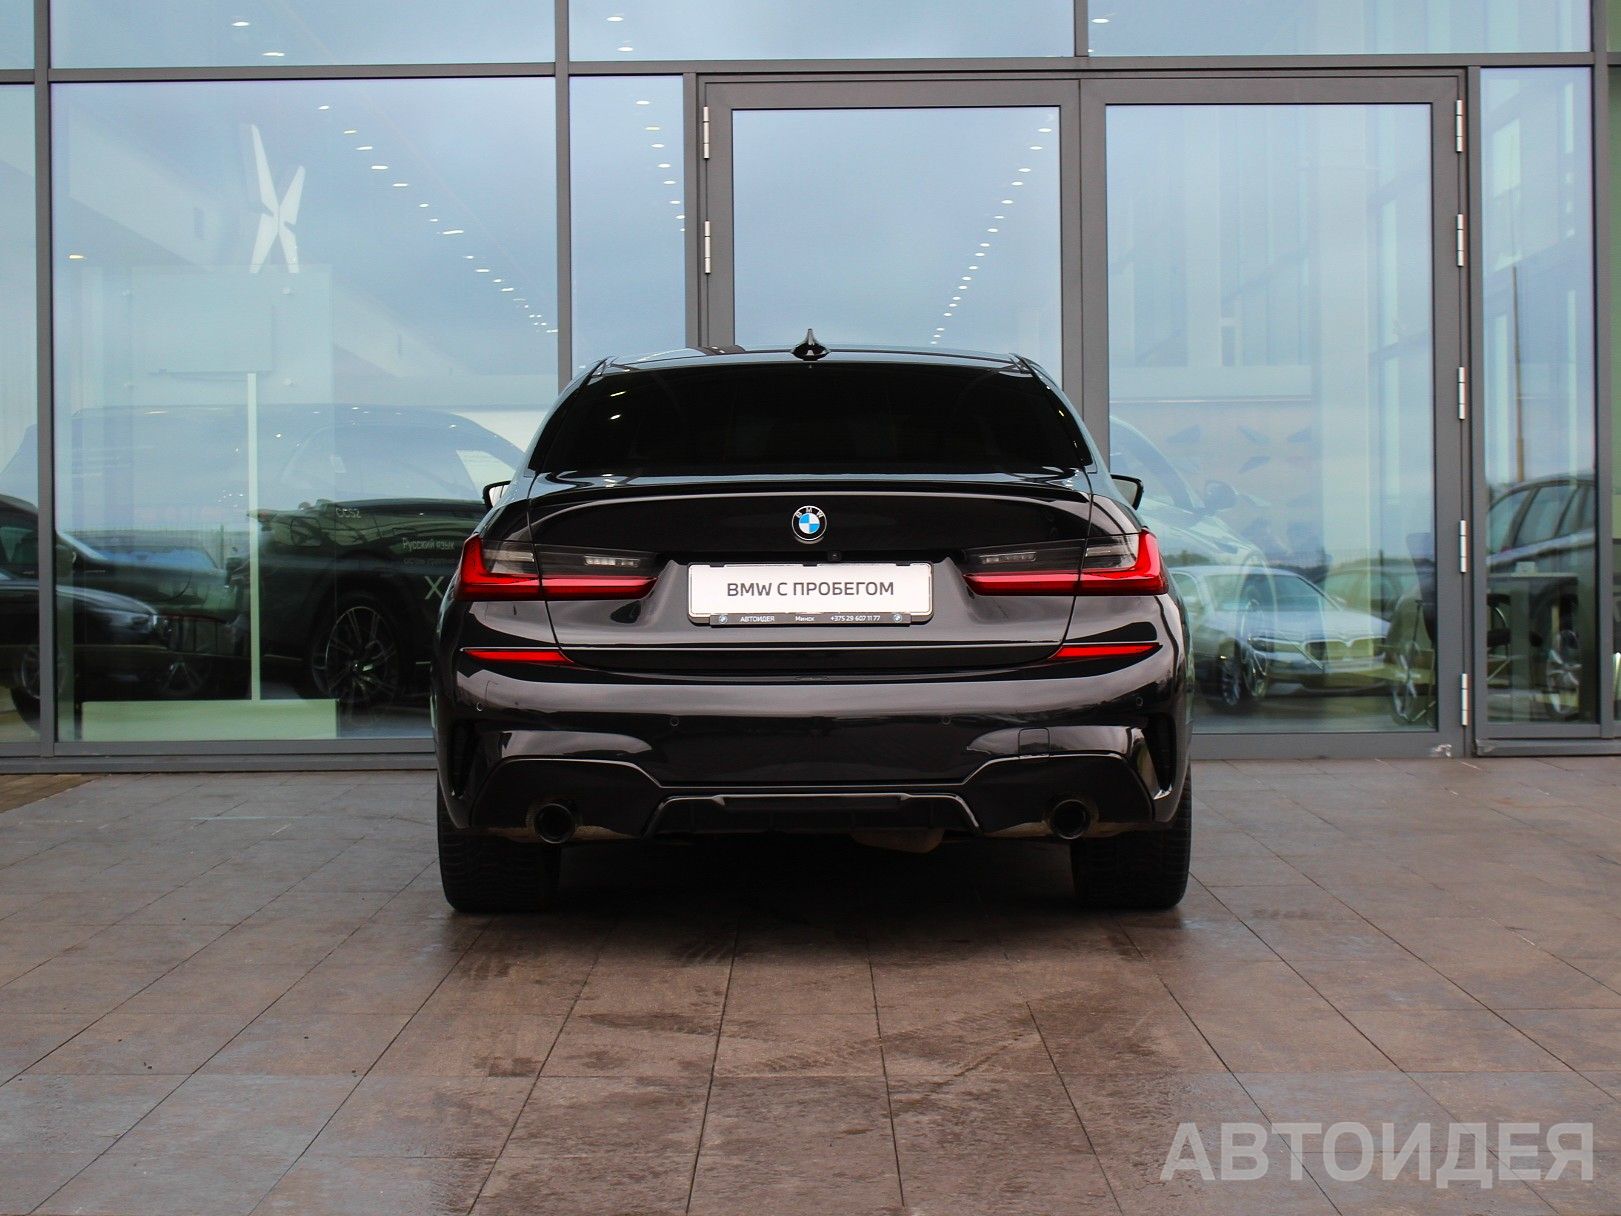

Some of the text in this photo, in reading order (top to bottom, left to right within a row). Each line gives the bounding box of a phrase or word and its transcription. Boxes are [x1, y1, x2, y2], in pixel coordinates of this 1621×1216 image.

[795, 507, 824, 518] BMW
[727, 582, 772, 597] BMW
[793, 581, 894, 597] ПРОБЕГОМ
